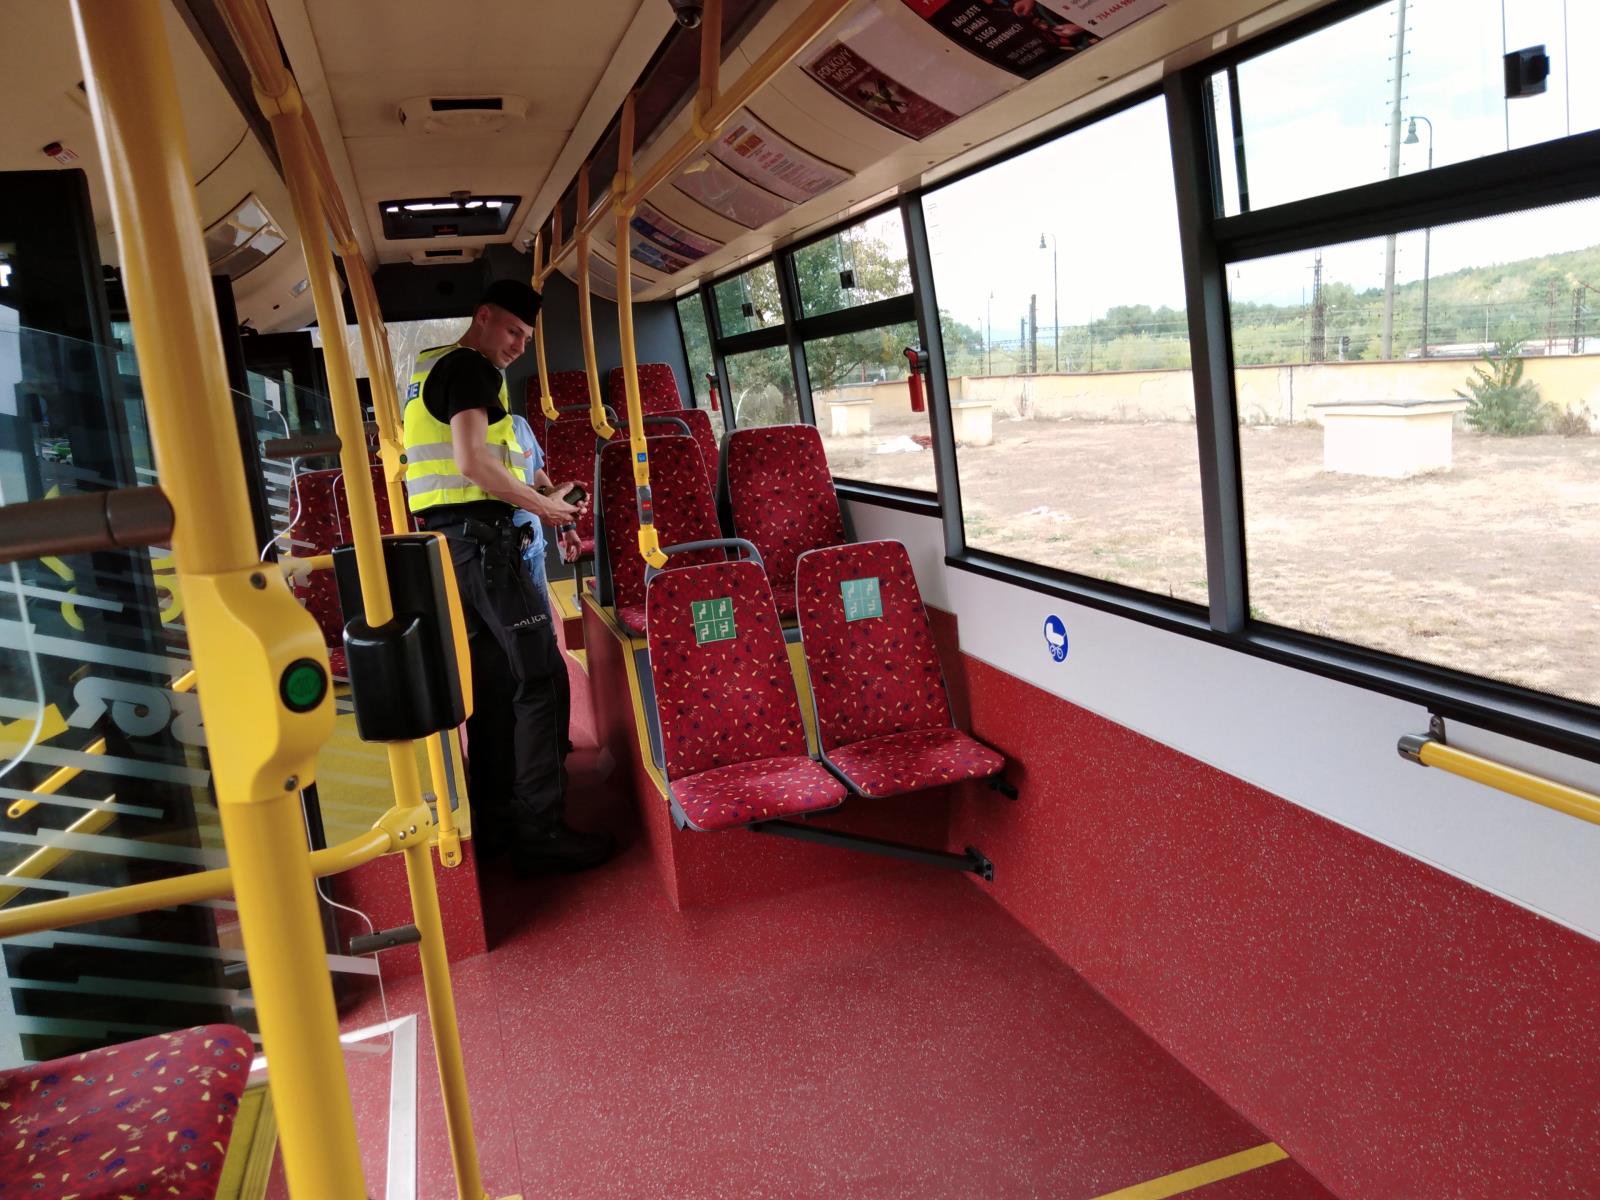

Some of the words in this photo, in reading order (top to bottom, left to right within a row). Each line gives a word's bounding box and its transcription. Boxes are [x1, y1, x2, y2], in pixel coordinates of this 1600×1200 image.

[980, 26, 997, 40] LEGO
[816, 47, 851, 79] FOLKOVÝ
[831, 61, 857, 82] MOST
